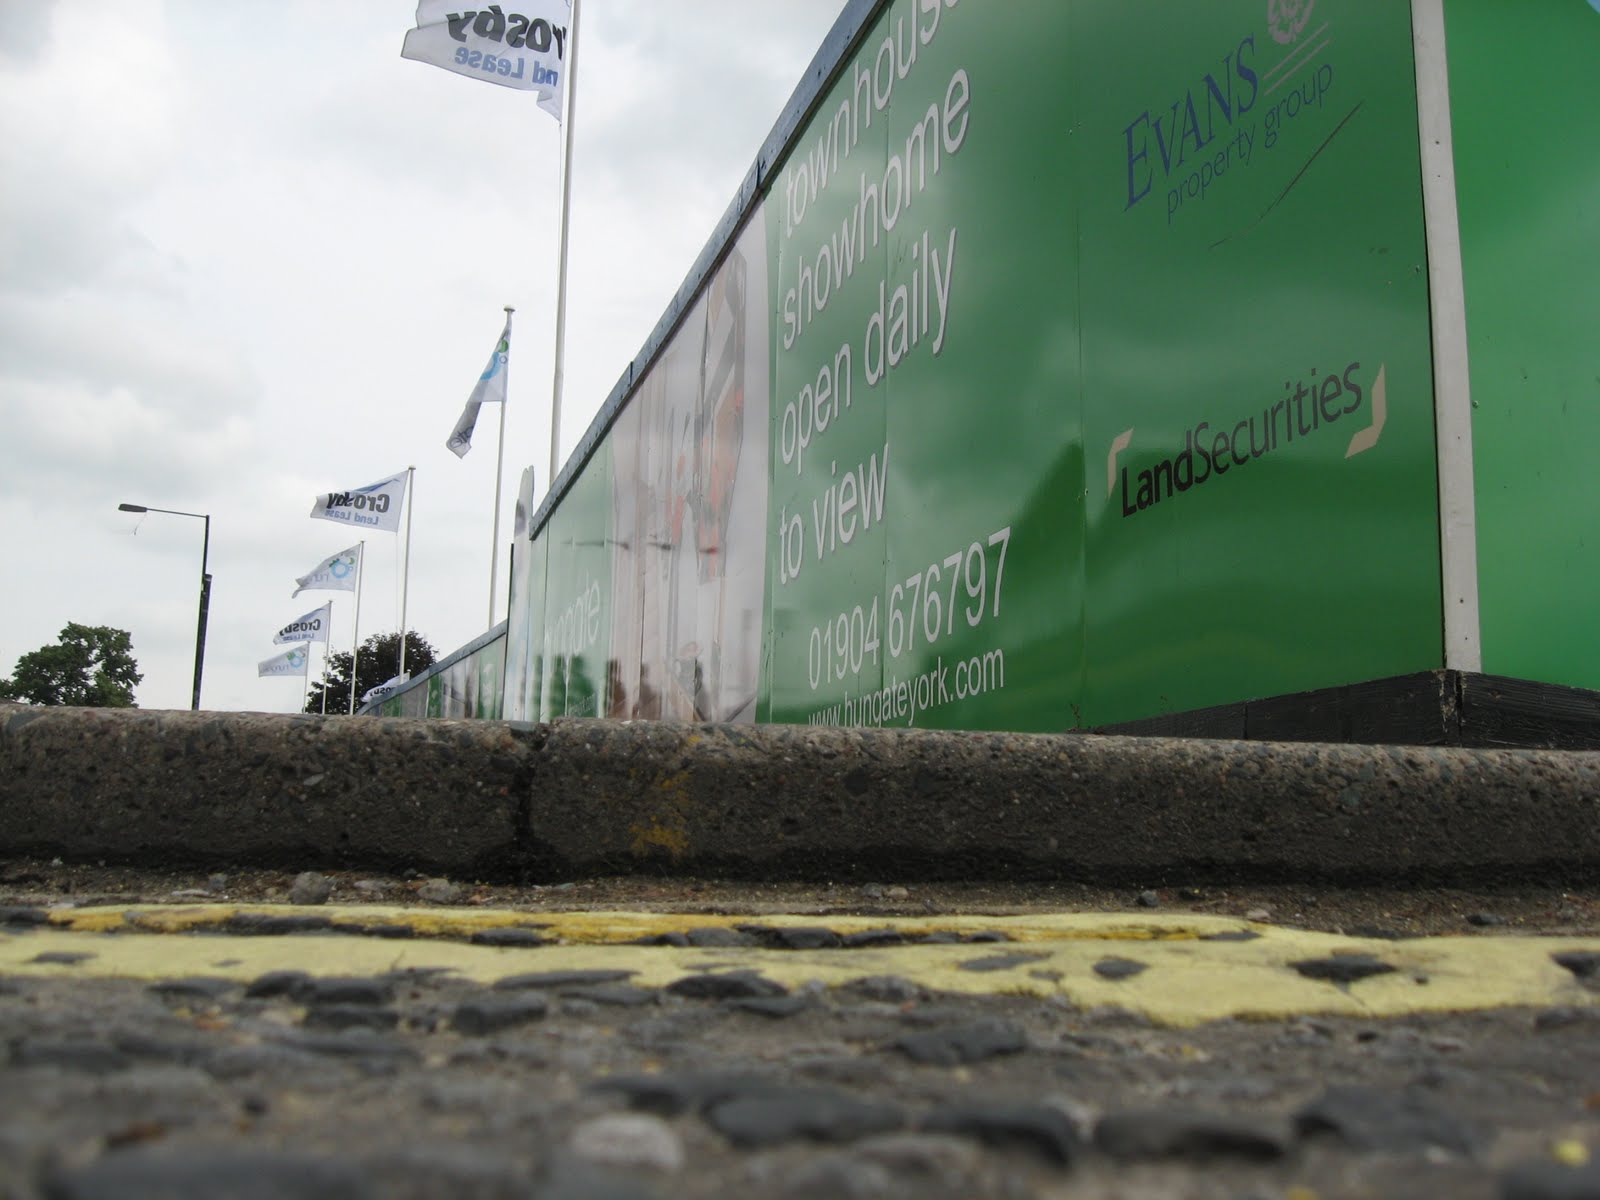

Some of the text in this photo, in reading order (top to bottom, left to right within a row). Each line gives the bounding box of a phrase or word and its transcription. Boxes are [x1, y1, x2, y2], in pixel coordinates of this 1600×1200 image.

[785, 0, 958, 239] townhous
[1121, 32, 1259, 213] EVANS
[1167, 63, 1333, 226] property group
[783, 68, 970, 350] showhome
[781, 227, 956, 475] open daily
[779, 442, 889, 585] to view
[1121, 361, 1362, 518] LandSecurities
[808, 526, 1010, 690] 01904 676797
[808, 647, 1005, 727] wwwhungateyork.com
